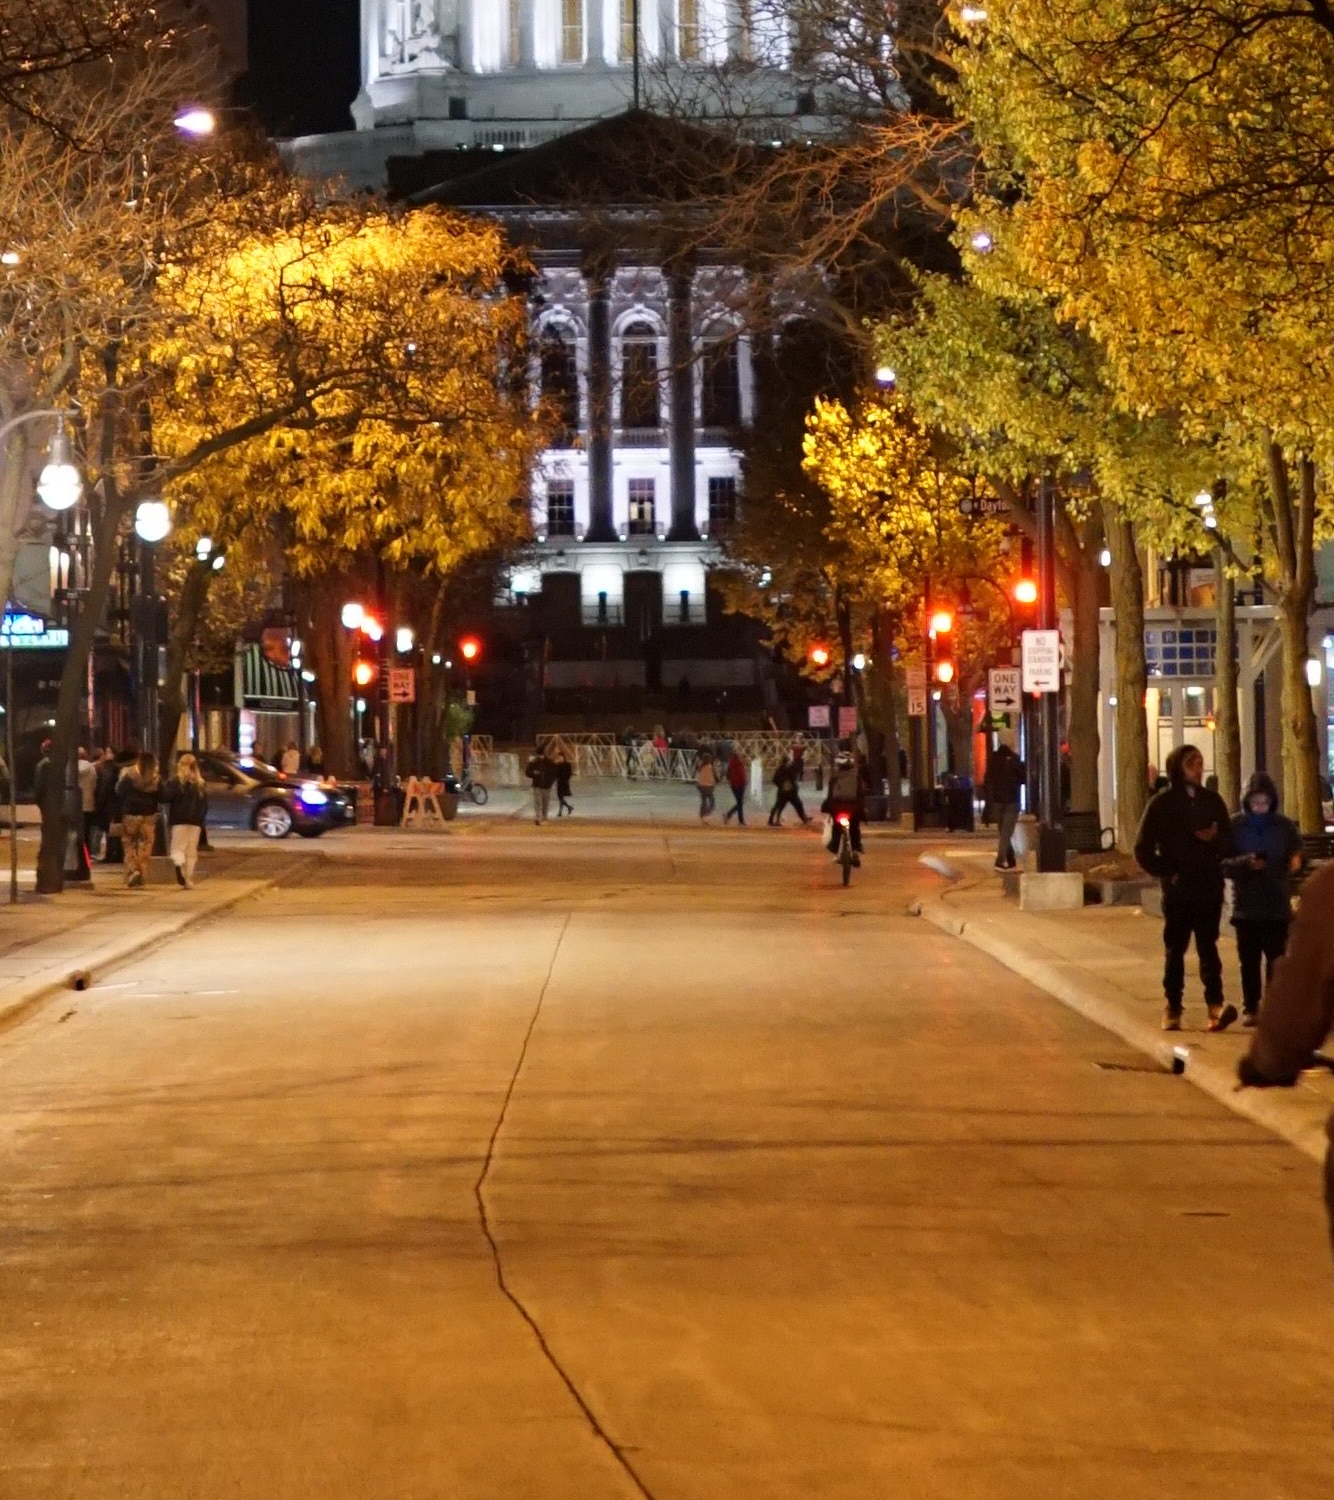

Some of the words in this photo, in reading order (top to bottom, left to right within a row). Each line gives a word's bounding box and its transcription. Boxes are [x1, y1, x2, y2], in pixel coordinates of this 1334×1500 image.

[980, 498, 1009, 513] Dayto
[1034, 636, 1046, 645] NO
[993, 673, 1017, 684] ONE
[993, 684, 1017, 695] WAY
[911, 702, 924, 713] 15
